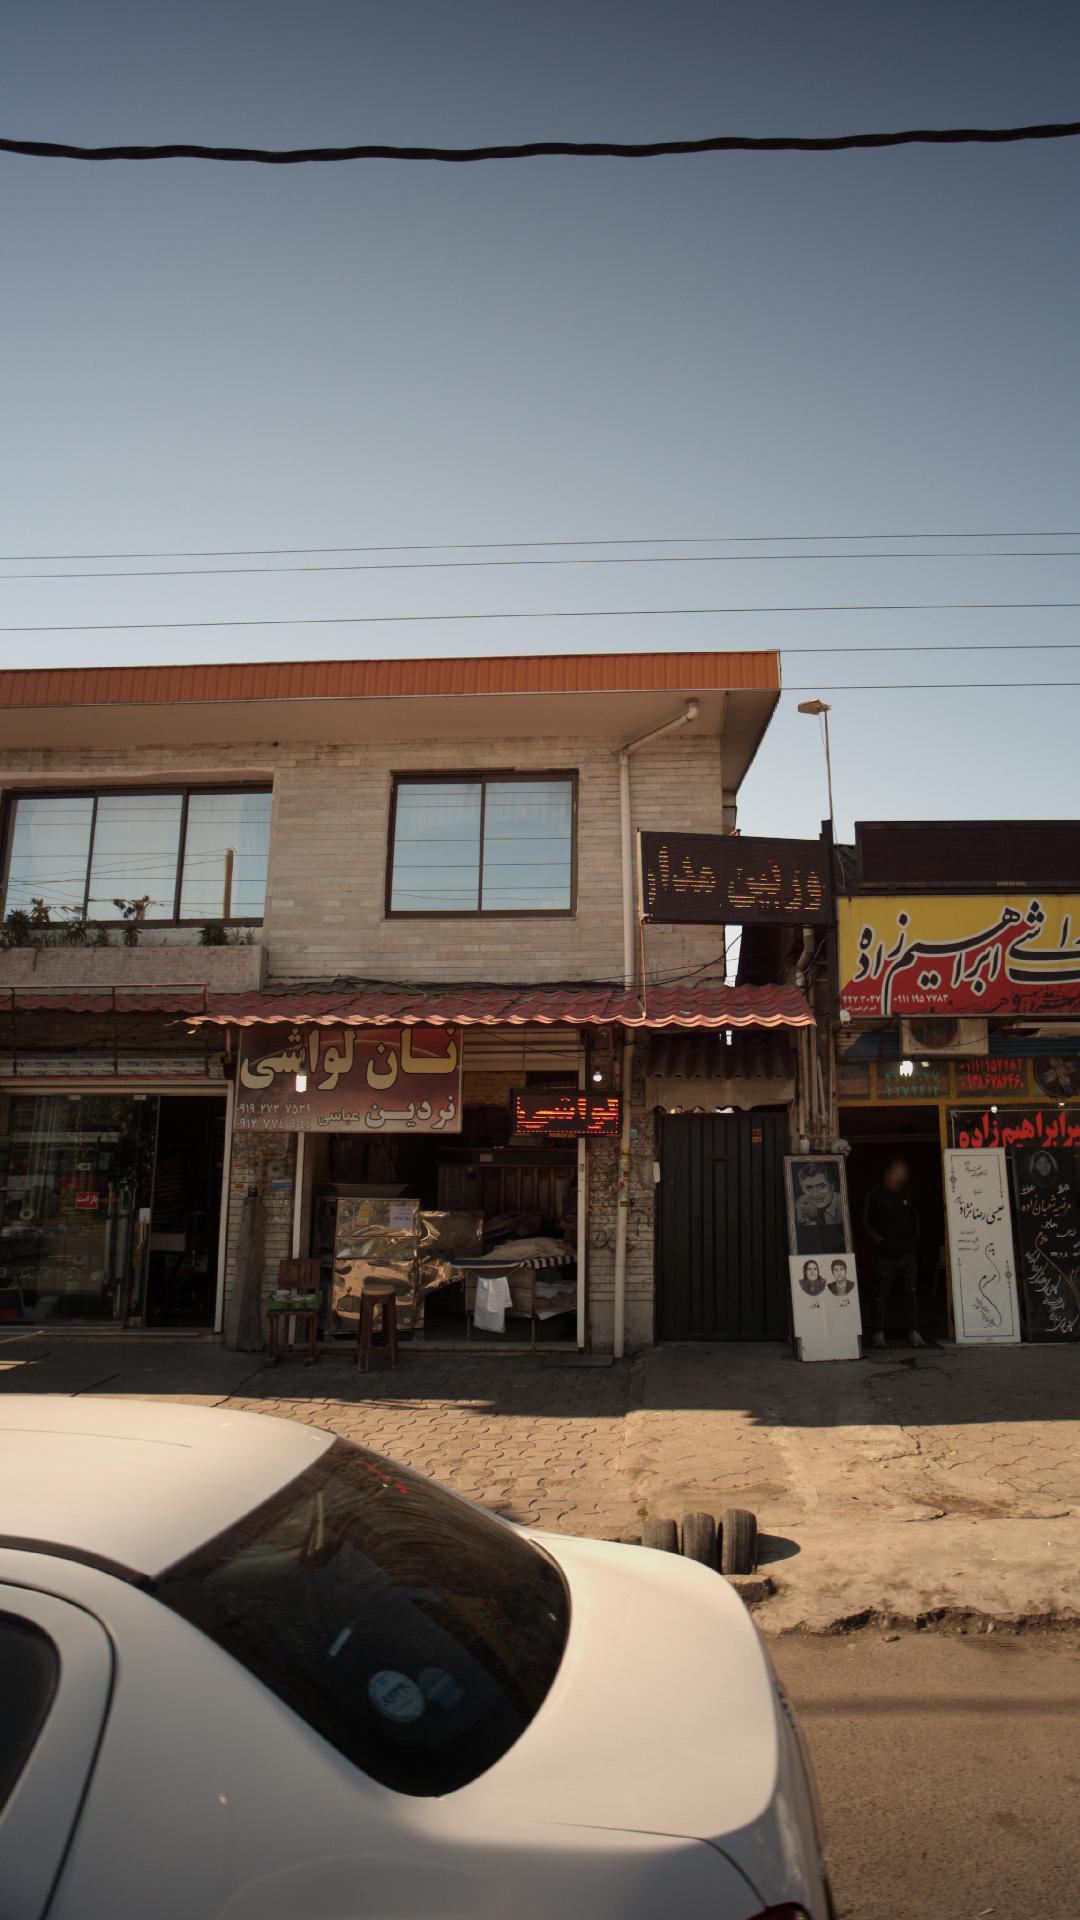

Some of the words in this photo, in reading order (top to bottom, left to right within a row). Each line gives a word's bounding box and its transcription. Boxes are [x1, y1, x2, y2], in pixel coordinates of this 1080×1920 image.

[853, 912, 909, 981] زاده
[884, 906, 1021, 1014] ابراهیم
[240, 1028, 357, 1090] لواشی
[366, 1028, 458, 1090] نان
[318, 1109, 360, 1126] عباسی
[365, 1096, 456, 1129] نردین
[959, 1111, 1000, 1148] زاده
[1001, 1110, 1066, 1148] ابراهیم
